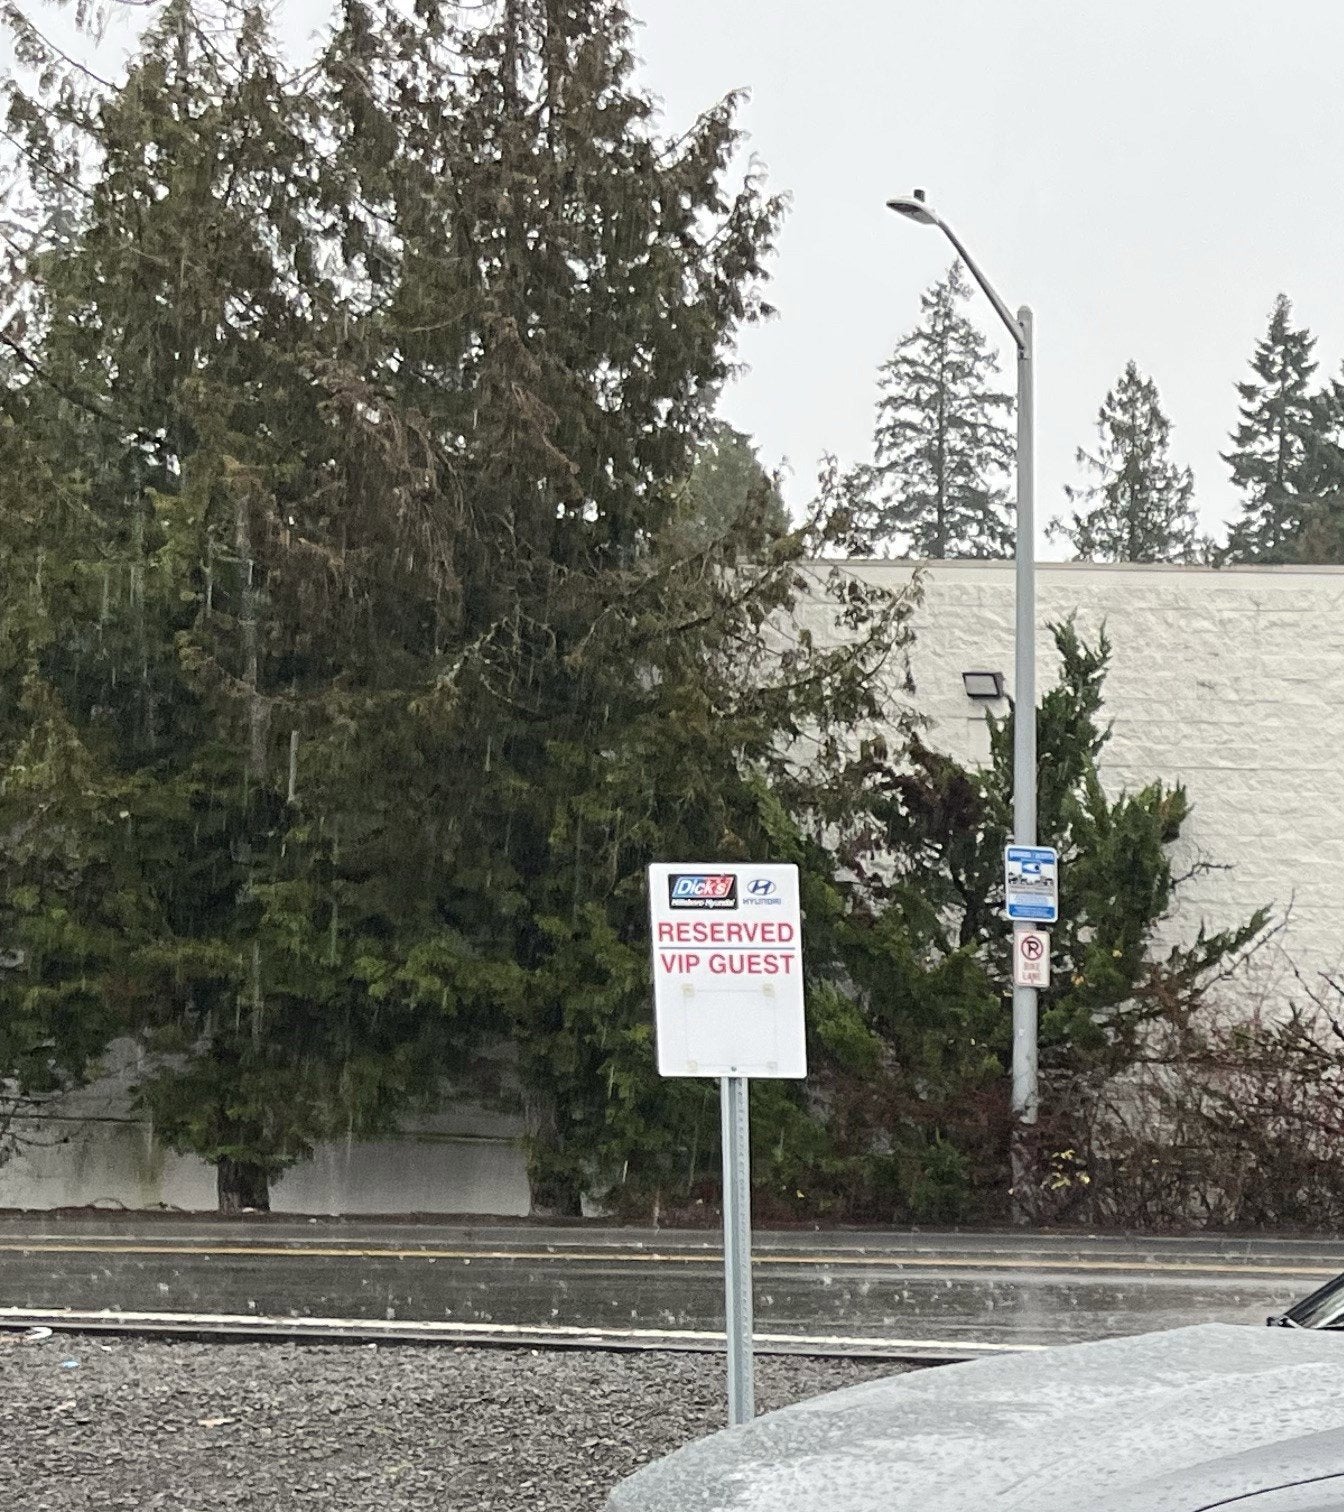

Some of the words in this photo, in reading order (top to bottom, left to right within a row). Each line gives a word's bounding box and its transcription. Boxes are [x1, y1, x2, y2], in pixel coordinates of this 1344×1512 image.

[677, 876, 727, 895] Dick's
[658, 922, 794, 942] RESERVED
[660, 954, 700, 973] VIP
[708, 954, 795, 974] GUEST
